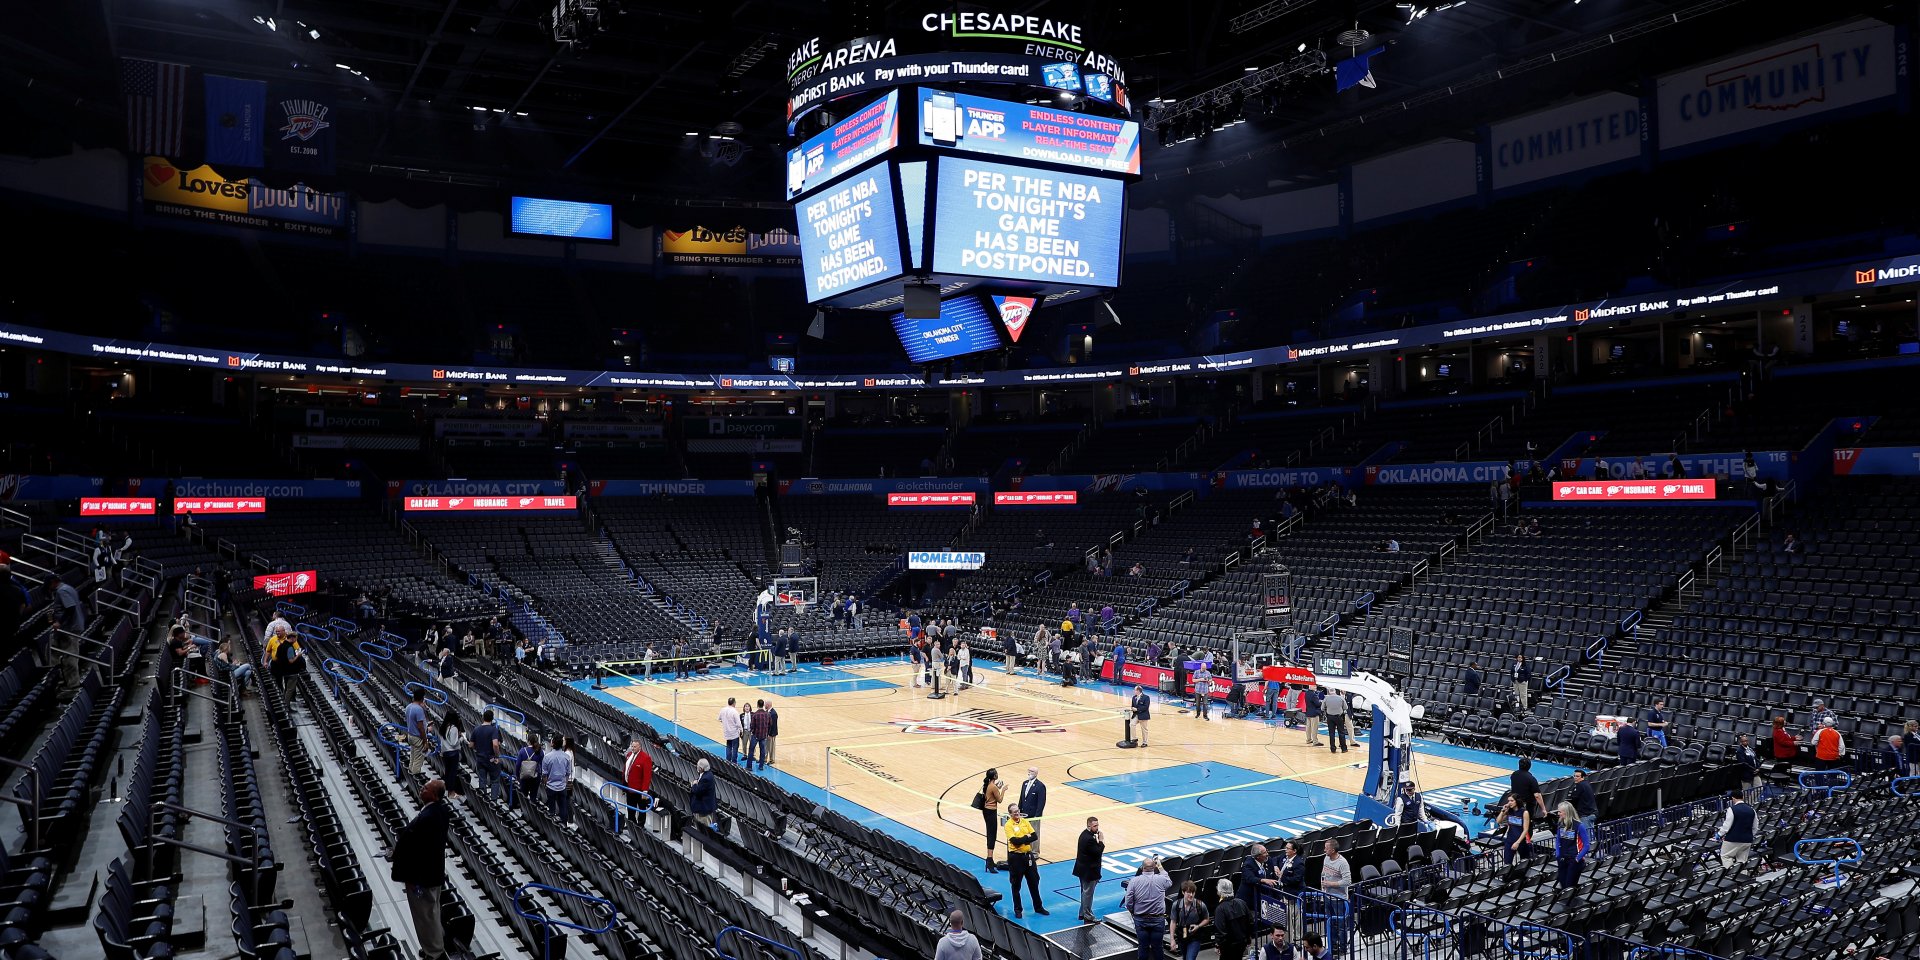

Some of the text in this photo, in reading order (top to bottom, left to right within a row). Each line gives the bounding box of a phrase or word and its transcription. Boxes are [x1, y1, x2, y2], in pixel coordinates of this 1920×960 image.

[922, 12, 1082, 44] CHESAPEAKE
[791, 38, 897, 91] ENERGY ARENA
[1025, 43, 1081, 63] ENERGY
[1084, 50, 1125, 86] ARENA
[830, 71, 865, 93] BANK
[875, 67, 894, 81] Pay
[897, 64, 921, 77] with
[924, 64, 950, 78] your
[952, 62, 1000, 75] Thunder
[1001, 64, 1029, 77] card!
[1679, 44, 1871, 122] COMMUNITY
[280, 98, 329, 119] THUNDER
[967, 109, 1005, 123] THUNDER
[835, 100, 887, 137] ENDLESS CONTENT
[1030, 109, 1122, 132] ENDLESS CONTENT
[967, 119, 1006, 139] APP
[1022, 121, 1130, 145] PLAYER INFORMATION
[1497, 109, 1639, 168] COMMITTED
[290, 146, 302, 155] EST.
[831, 133, 852, 151] PLAYER
[1035, 135, 1118, 156] REAL-TIME STATS
[806, 154, 825, 177] APP
[1023, 147, 1130, 171] DOWNLOAD FOR FREE
[964, 169, 1101, 203] PER THE NBA
[807, 177, 879, 223] PER THE NBA
[973, 190, 1086, 220] TONIGHT'S
[155, 203, 332, 236] BRING THE THUNDER EXIT NOW
[813, 200, 872, 238] TONIGHT'S
[998, 214, 1060, 236] GAME
[828, 224, 861, 250] GAME
[975, 230, 1079, 258] HAS BEEN
[673, 255, 796, 265] BRING THE THUNDER EXIT
[821, 238, 875, 273] HAS BEEN
[961, 249, 1095, 278] POSTPONED.
[817, 256, 888, 293] POSTPONED.
[1639, 300, 1669, 312] BANK
[1677, 286, 1779, 307] Pay with your Thunder card!
[922, 323, 965, 339] OKLAHOMA CITY
[1453, 328, 1472, 336] Official
[1472, 326, 1486, 334] Bank
[1503, 320, 1531, 330] Oklahoma
[1531, 318, 1543, 326] City
[1543, 315, 1568, 324] Thunder
[934, 333, 960, 346] THUNDER
[1329, 344, 1349, 353] BANK
[92, 344, 104, 352] The
[105, 345, 126, 354] Official
[126, 347, 142, 355] Bank
[159, 351, 186, 360] Oklahoma
[187, 353, 197, 362] City
[198, 355, 220, 363] Thunder
[282, 361, 307, 371] BANK
[316, 364, 326, 372] Pay
[327, 365, 338, 373] with
[352, 367, 372, 375] Thunder
[1172, 363, 1191, 371] BANK
[485, 372, 508, 380] BANK
[769, 379, 789, 387] BANK
[326, 417, 380, 430] paycom
[728, 422, 775, 433] paycom
[1769, 452, 1787, 462] 116
[1834, 450, 1854, 460] 117
[1366, 461, 1529, 484] 115 OKLAHOMA CITY 115
[1563, 458, 1744, 476] 116 THE
[387, 480, 400, 488] 110
[412, 483, 502, 496] OKLAHOMA
[505, 483, 541, 496] CITY
[590, 480, 600, 488] 111
[639, 483, 705, 494] THUNDER
[828, 482, 873, 492] OKLAHOMA
[895, 481, 963, 491] @okcthunder
[1236, 471, 1319, 487] WELCOME TO
[176, 482, 304, 498] okcthunder.com
[1576, 485, 1704, 495] CAR CARE INSURANCE TRAVEL
[410, 498, 565, 508] CAR CARE INSURANCE TRAVEL
[910, 552, 982, 564] HOMELAND
[1320, 658, 1335, 667] Life
[1322, 666, 1343, 675] Share
